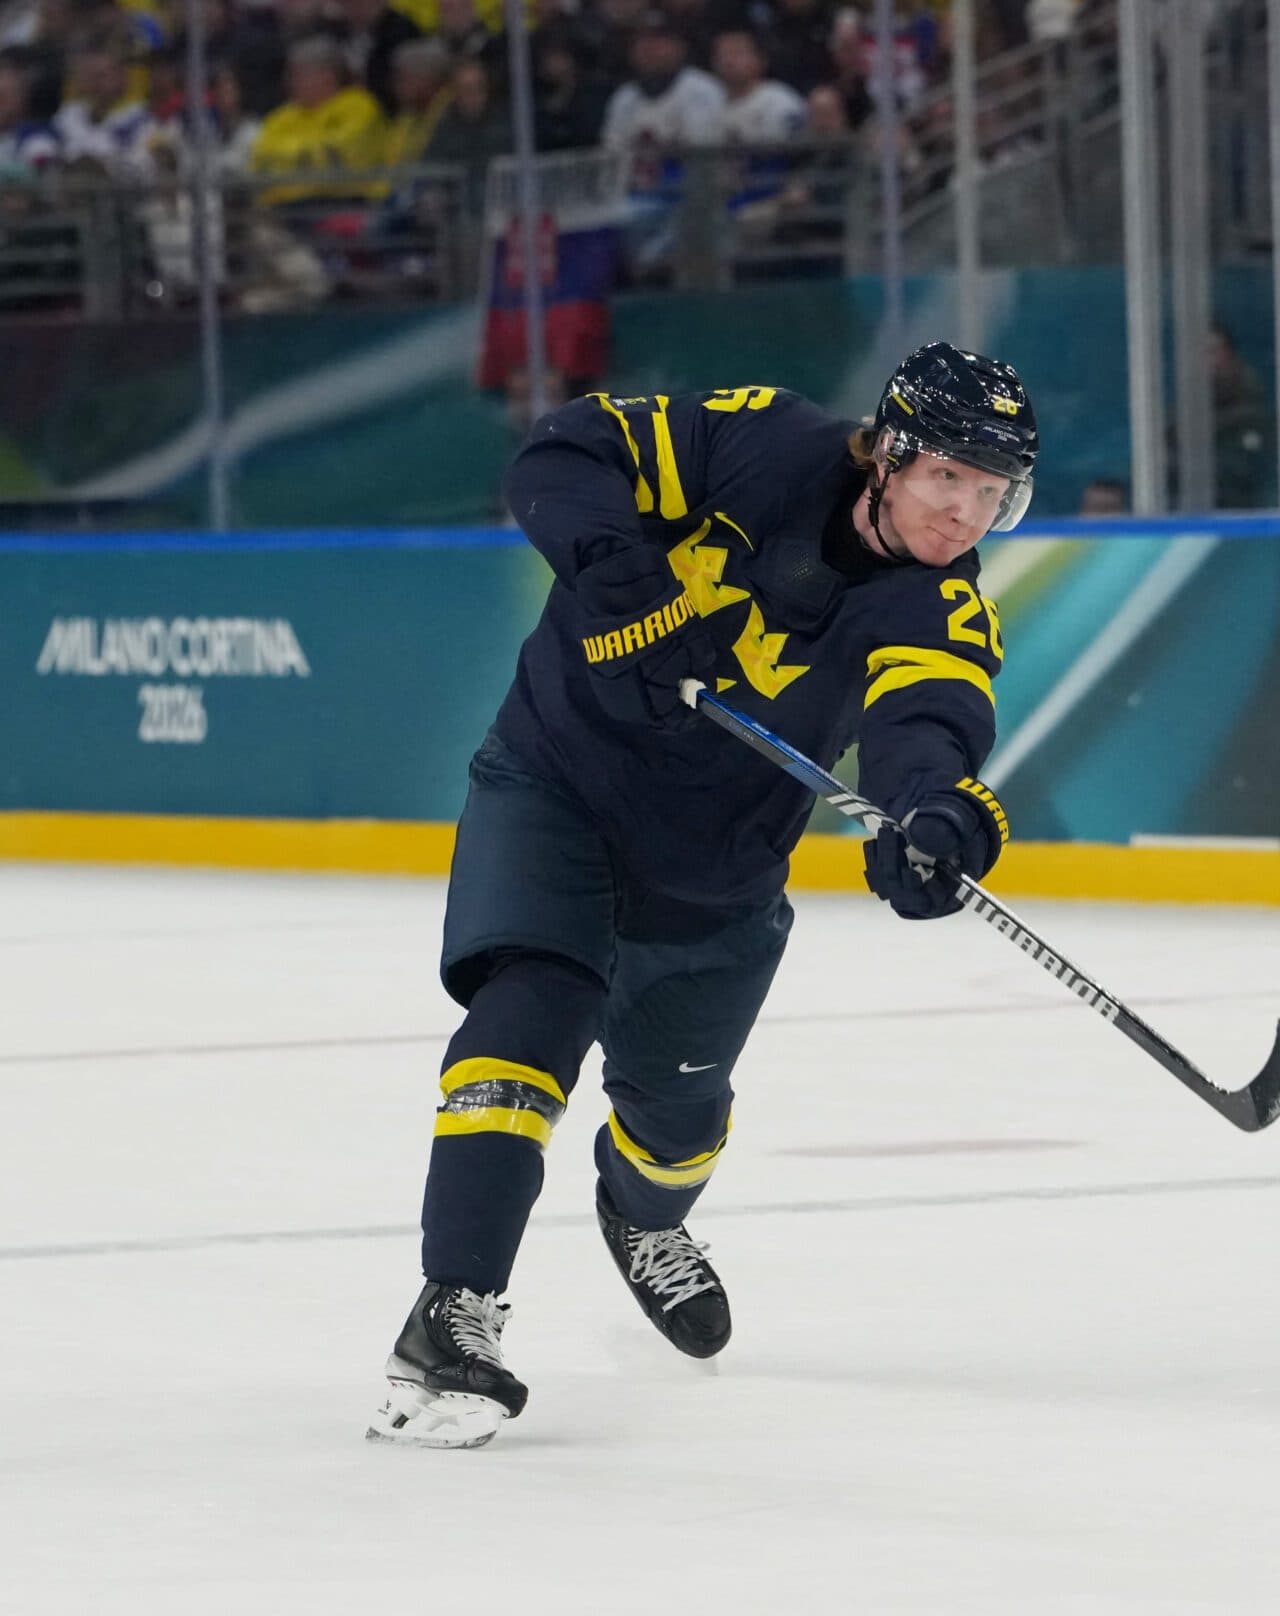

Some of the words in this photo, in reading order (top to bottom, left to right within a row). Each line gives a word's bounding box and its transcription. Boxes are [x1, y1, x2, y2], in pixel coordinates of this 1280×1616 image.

[993, 395, 1018, 415] 26
[36, 616, 167, 677] MILANO
[168, 616, 312, 678] CORTINA
[582, 589, 697, 664] WARRIOR
[136, 682, 208, 745] 2026
[955, 883, 1121, 1025] WARRIOR
